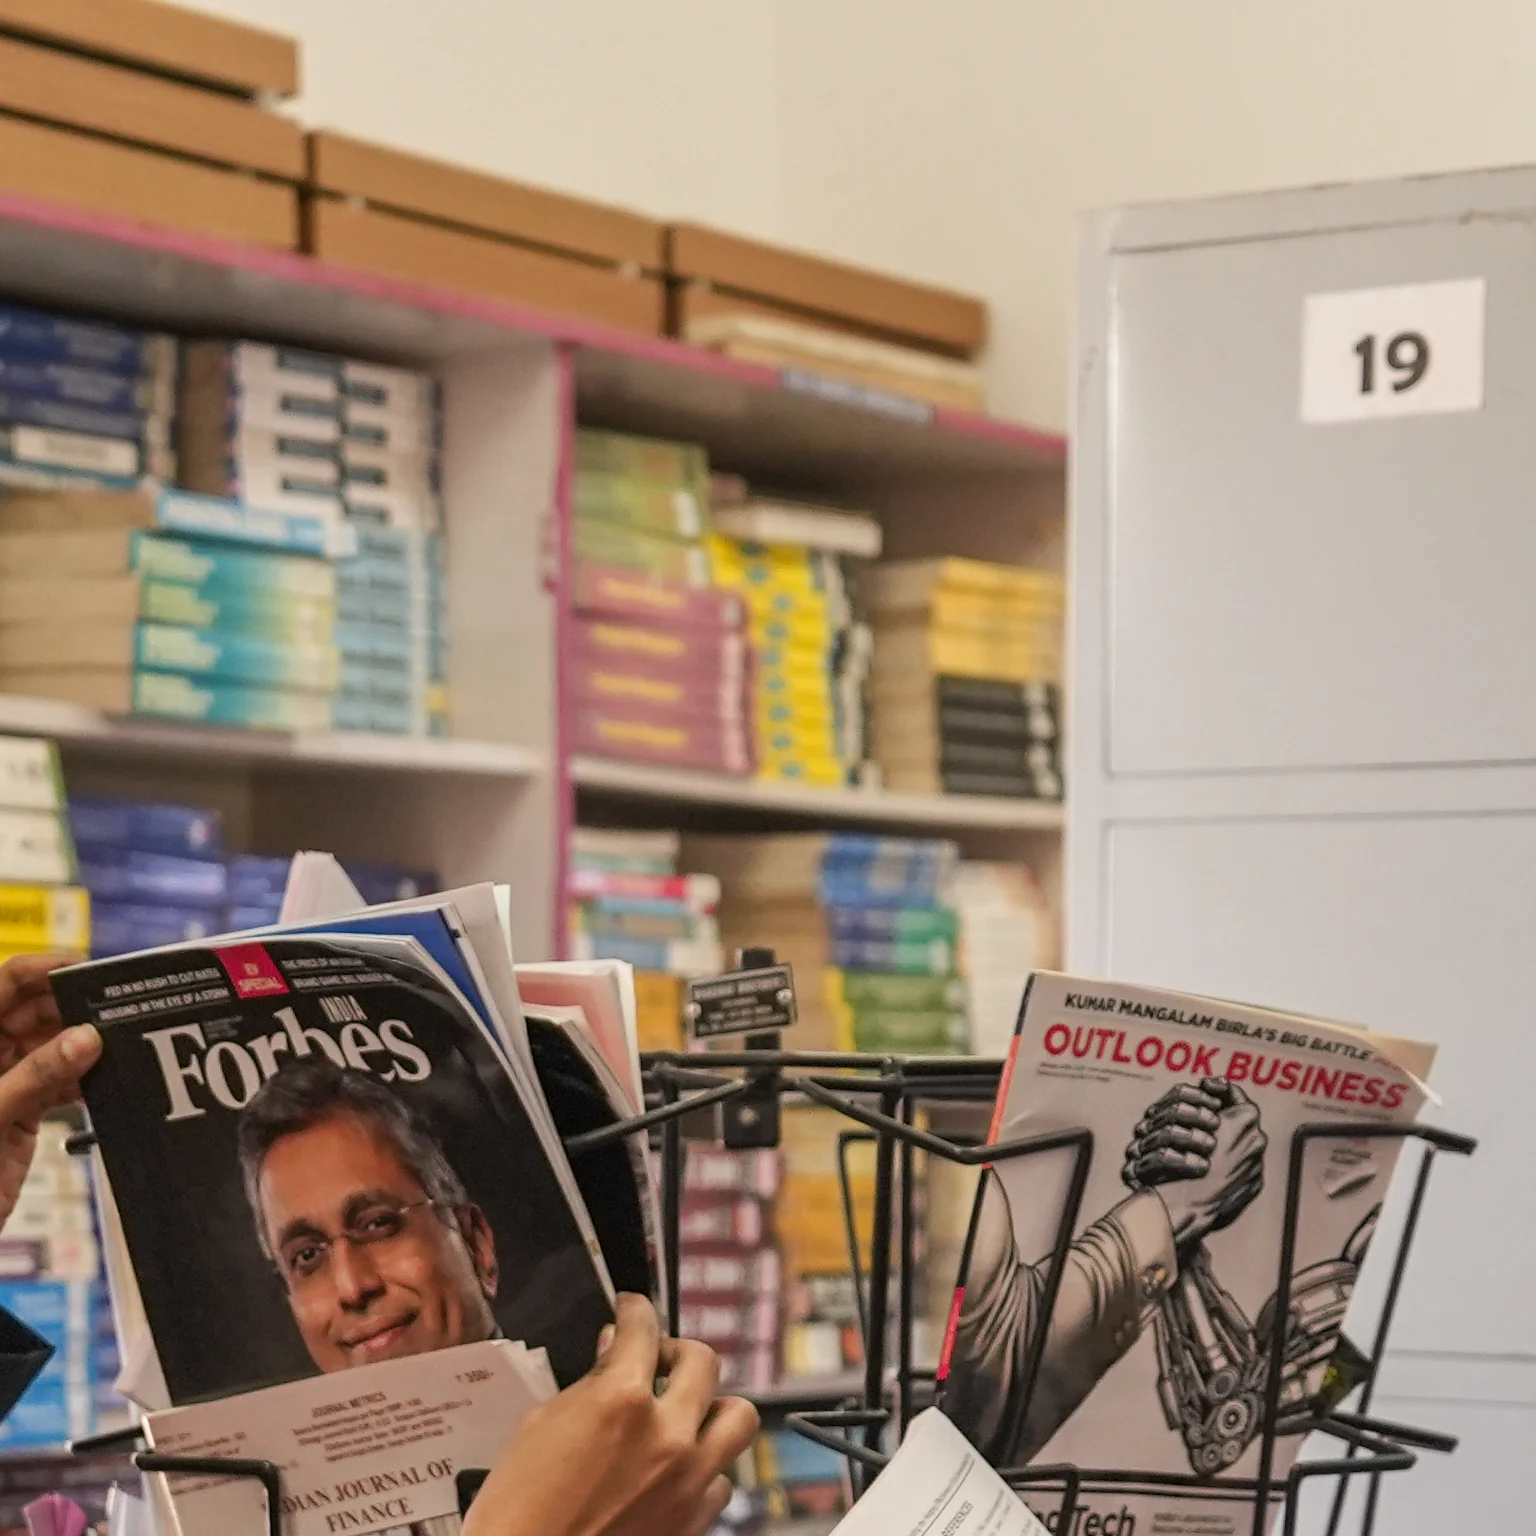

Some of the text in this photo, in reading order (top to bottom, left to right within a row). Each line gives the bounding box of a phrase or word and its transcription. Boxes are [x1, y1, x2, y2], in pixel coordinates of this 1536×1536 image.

[1352, 332, 1430, 394] 19
[237, 977, 283, 992] SPECIAL
[319, 994, 368, 1023] INDIA
[1064, 993, 1372, 1060] KUMAR MANGALAM BIRLA'S BIG BATTLE
[143, 1007, 432, 1120] Forbes
[1043, 1024, 1222, 1077] OUTLOOK
[1224, 1056, 1408, 1109] BUSINESS
[262, 1458, 455, 1518] DIAN JOURNAL OF
[326, 1497, 414, 1534] FINANCE
